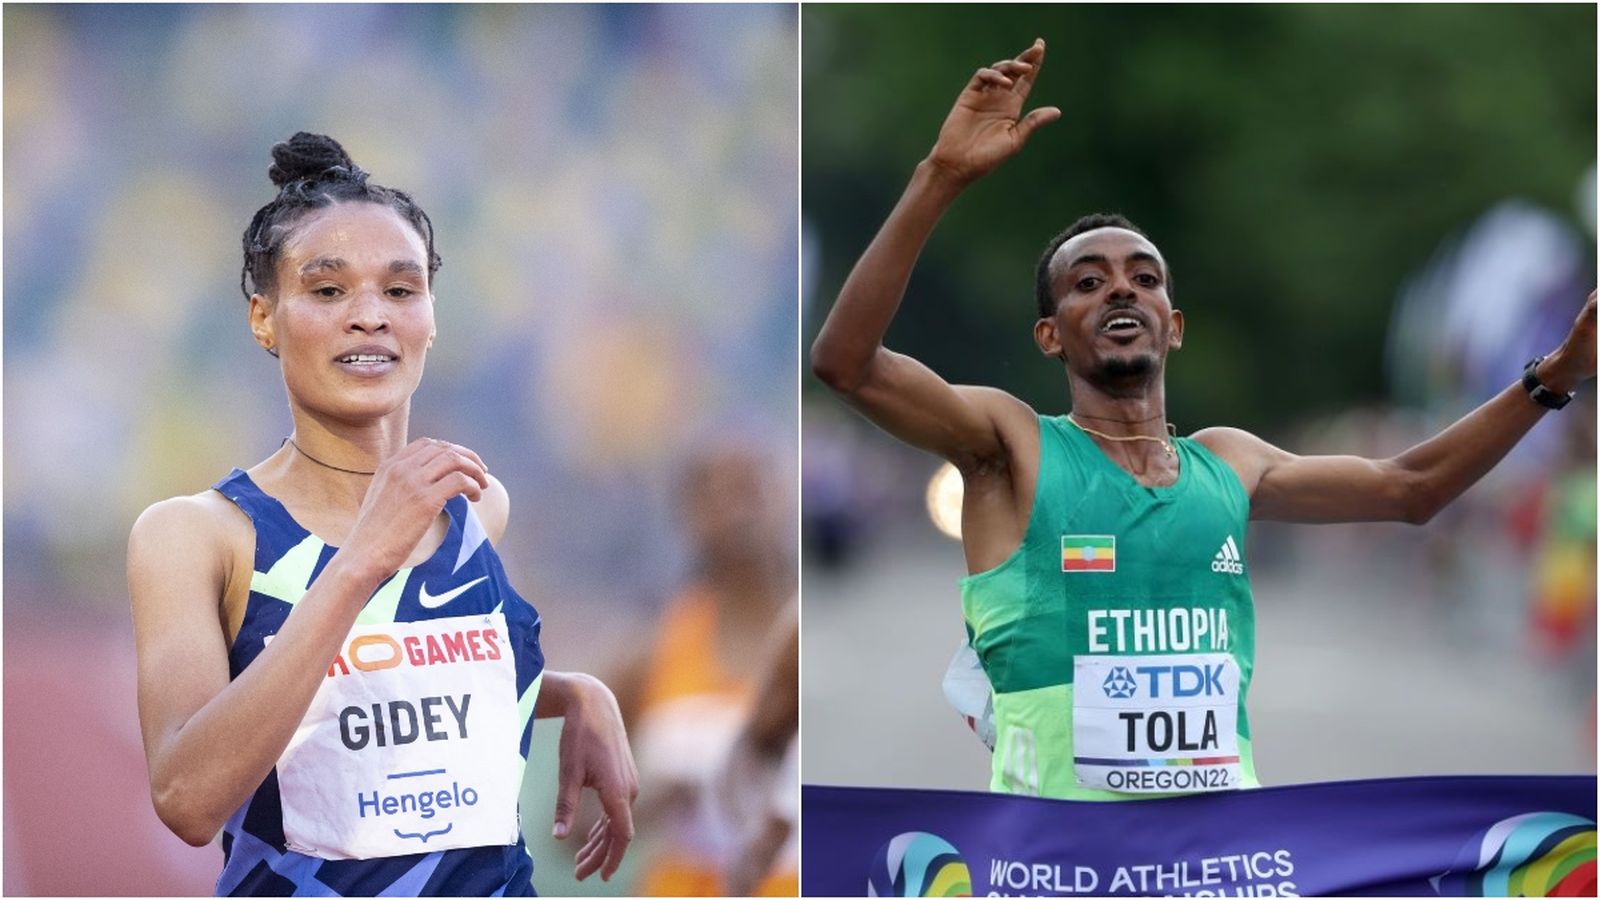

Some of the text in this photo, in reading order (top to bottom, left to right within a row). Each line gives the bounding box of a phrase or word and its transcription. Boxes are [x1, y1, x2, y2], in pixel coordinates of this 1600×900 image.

[1211, 558, 1243, 575] adidas
[403, 629, 502, 667] GAMES
[1087, 608, 1229, 653] ETHIOPIA
[1136, 664, 1225, 698] TDK
[339, 694, 471, 751] GIDEY
[1119, 710, 1219, 752] TOLA
[1106, 768, 1229, 790] OREGON22
[358, 782, 478, 819] Hengelo
[990, 858, 1099, 893] WORLD
[1109, 849, 1294, 893] ATHLETICS
